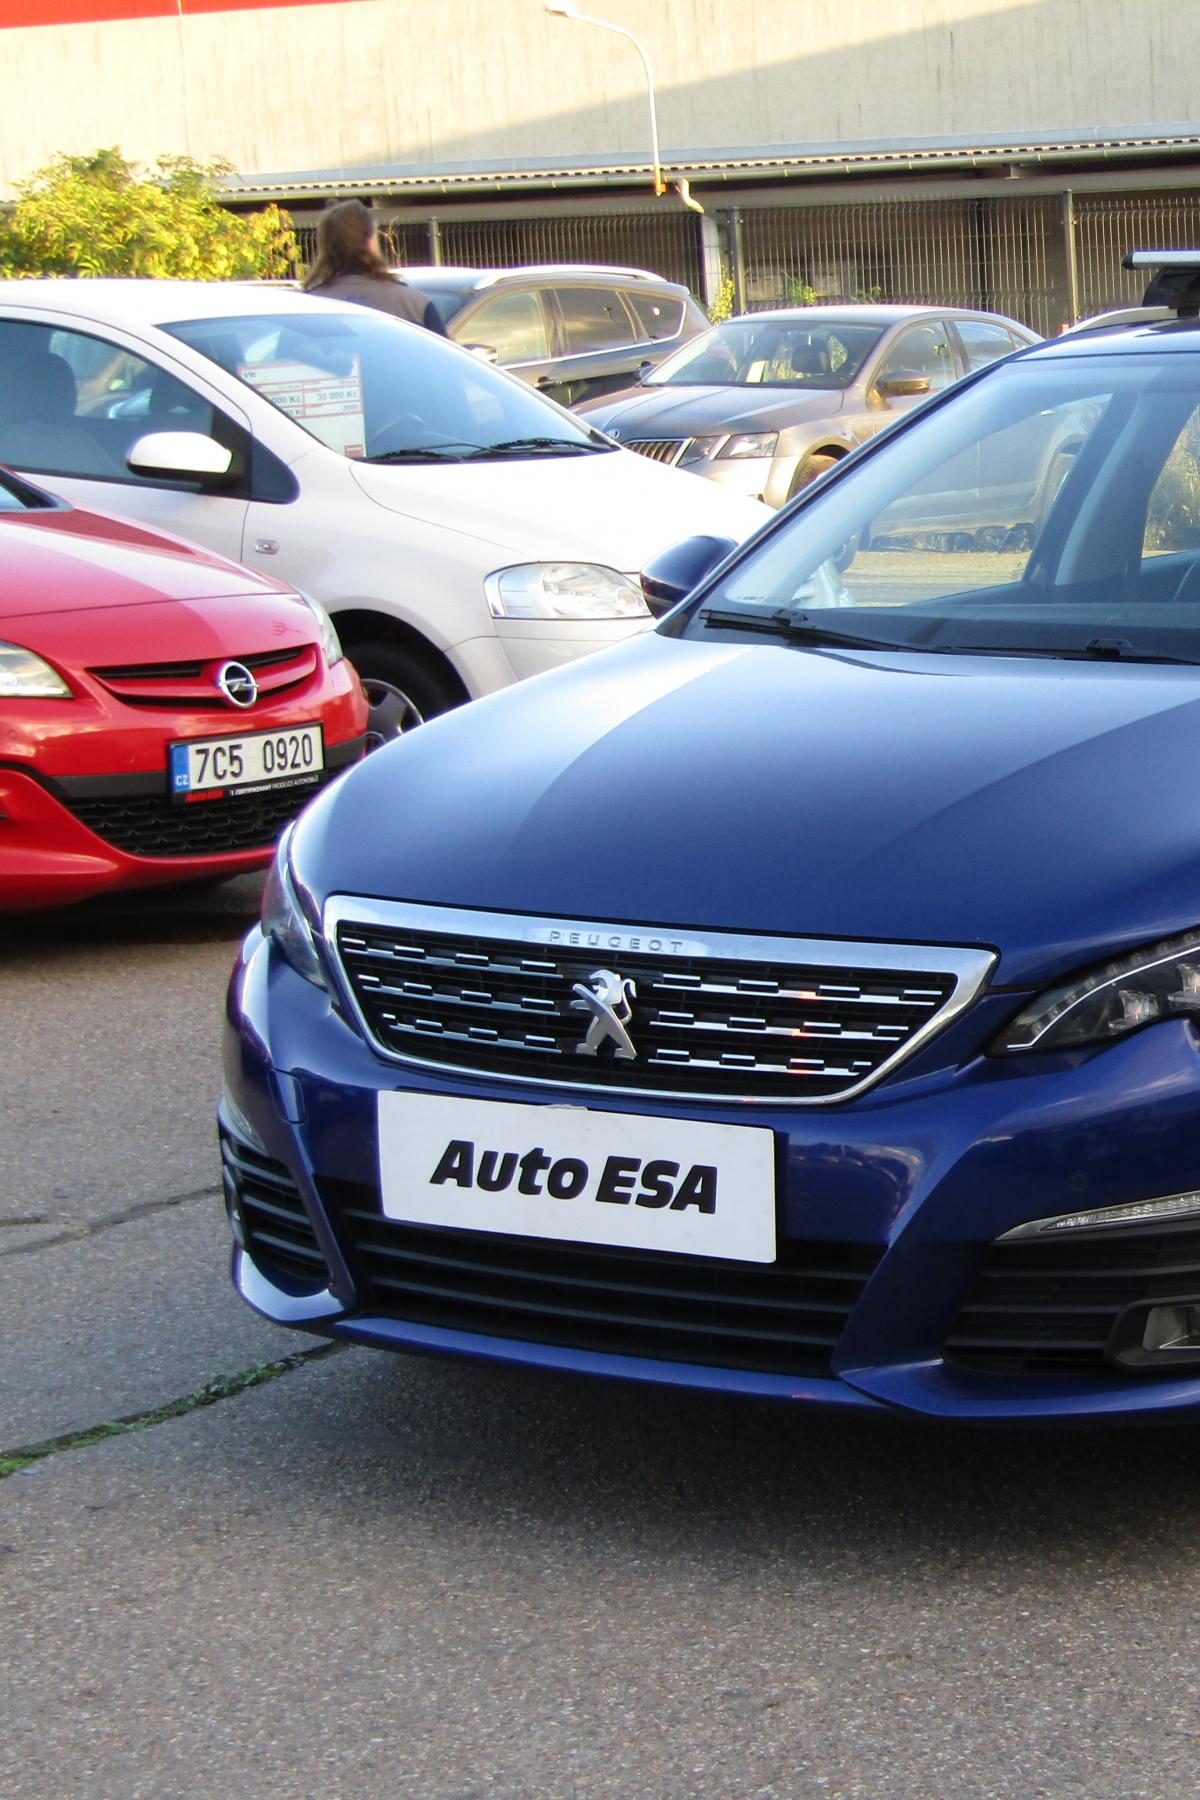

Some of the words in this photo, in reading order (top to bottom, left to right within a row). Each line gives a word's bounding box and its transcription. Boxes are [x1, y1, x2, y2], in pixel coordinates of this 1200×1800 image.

[329, 391, 345, 400] 000
[196, 744, 244, 784] 7C5
[263, 733, 313, 773] 0920
[175, 776, 189, 786] CZ
[550, 930, 683, 953] PEUGEOT
[429, 1140, 589, 1200] Auto
[595, 1155, 718, 1215] ESA
